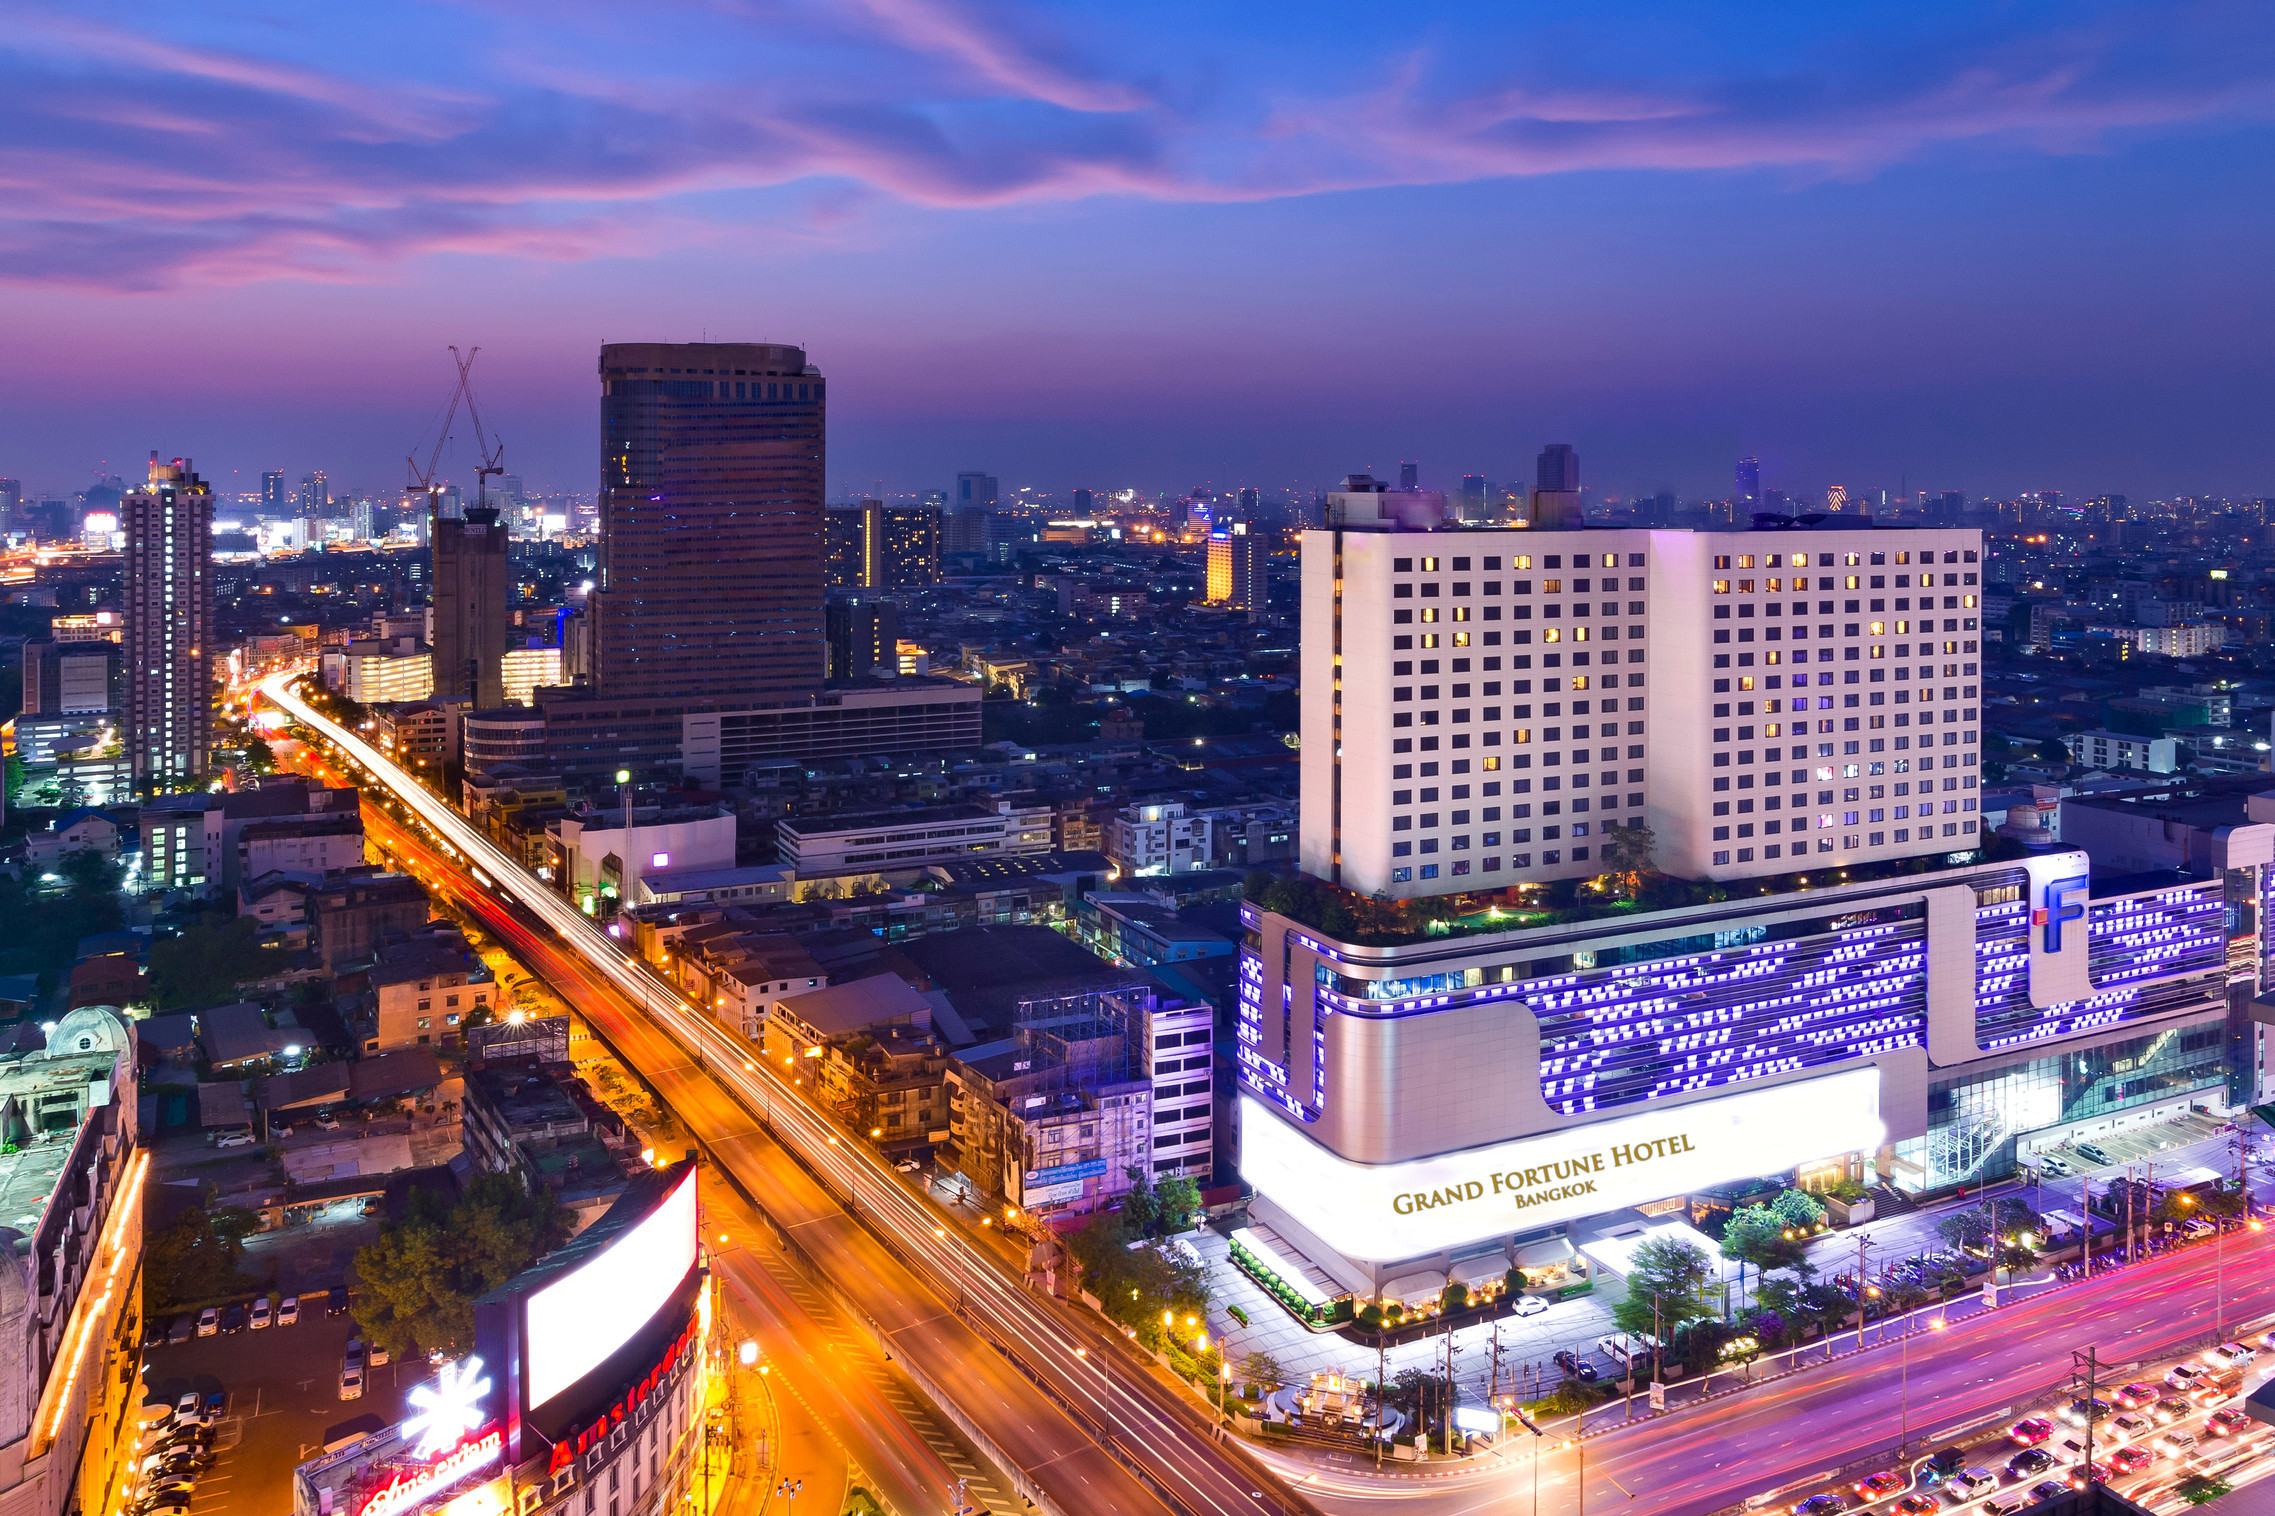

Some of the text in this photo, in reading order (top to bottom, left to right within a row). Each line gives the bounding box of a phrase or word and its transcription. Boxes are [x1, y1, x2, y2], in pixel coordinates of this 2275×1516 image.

[1393, 1134, 1696, 1215] GRAND FORTUNE HOTEL
[1515, 1180, 1598, 1209] BANGKOK
